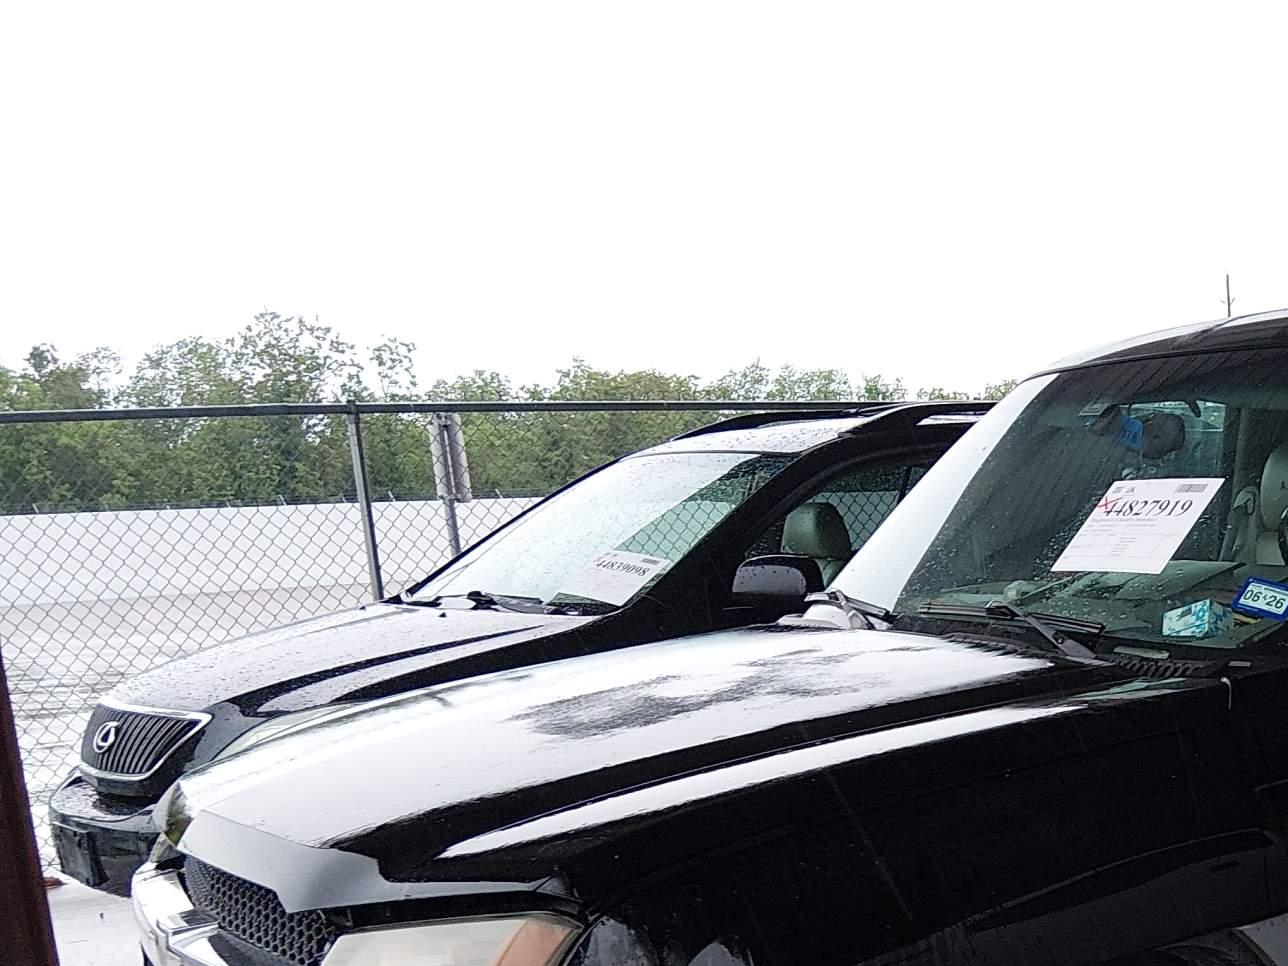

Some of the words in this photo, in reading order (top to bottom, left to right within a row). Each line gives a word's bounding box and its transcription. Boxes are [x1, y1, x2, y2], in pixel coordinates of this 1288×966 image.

[1104, 498, 1193, 517] 44827919
[1243, 589, 1263, 603] 06
[1265, 595, 1286, 609] 26
